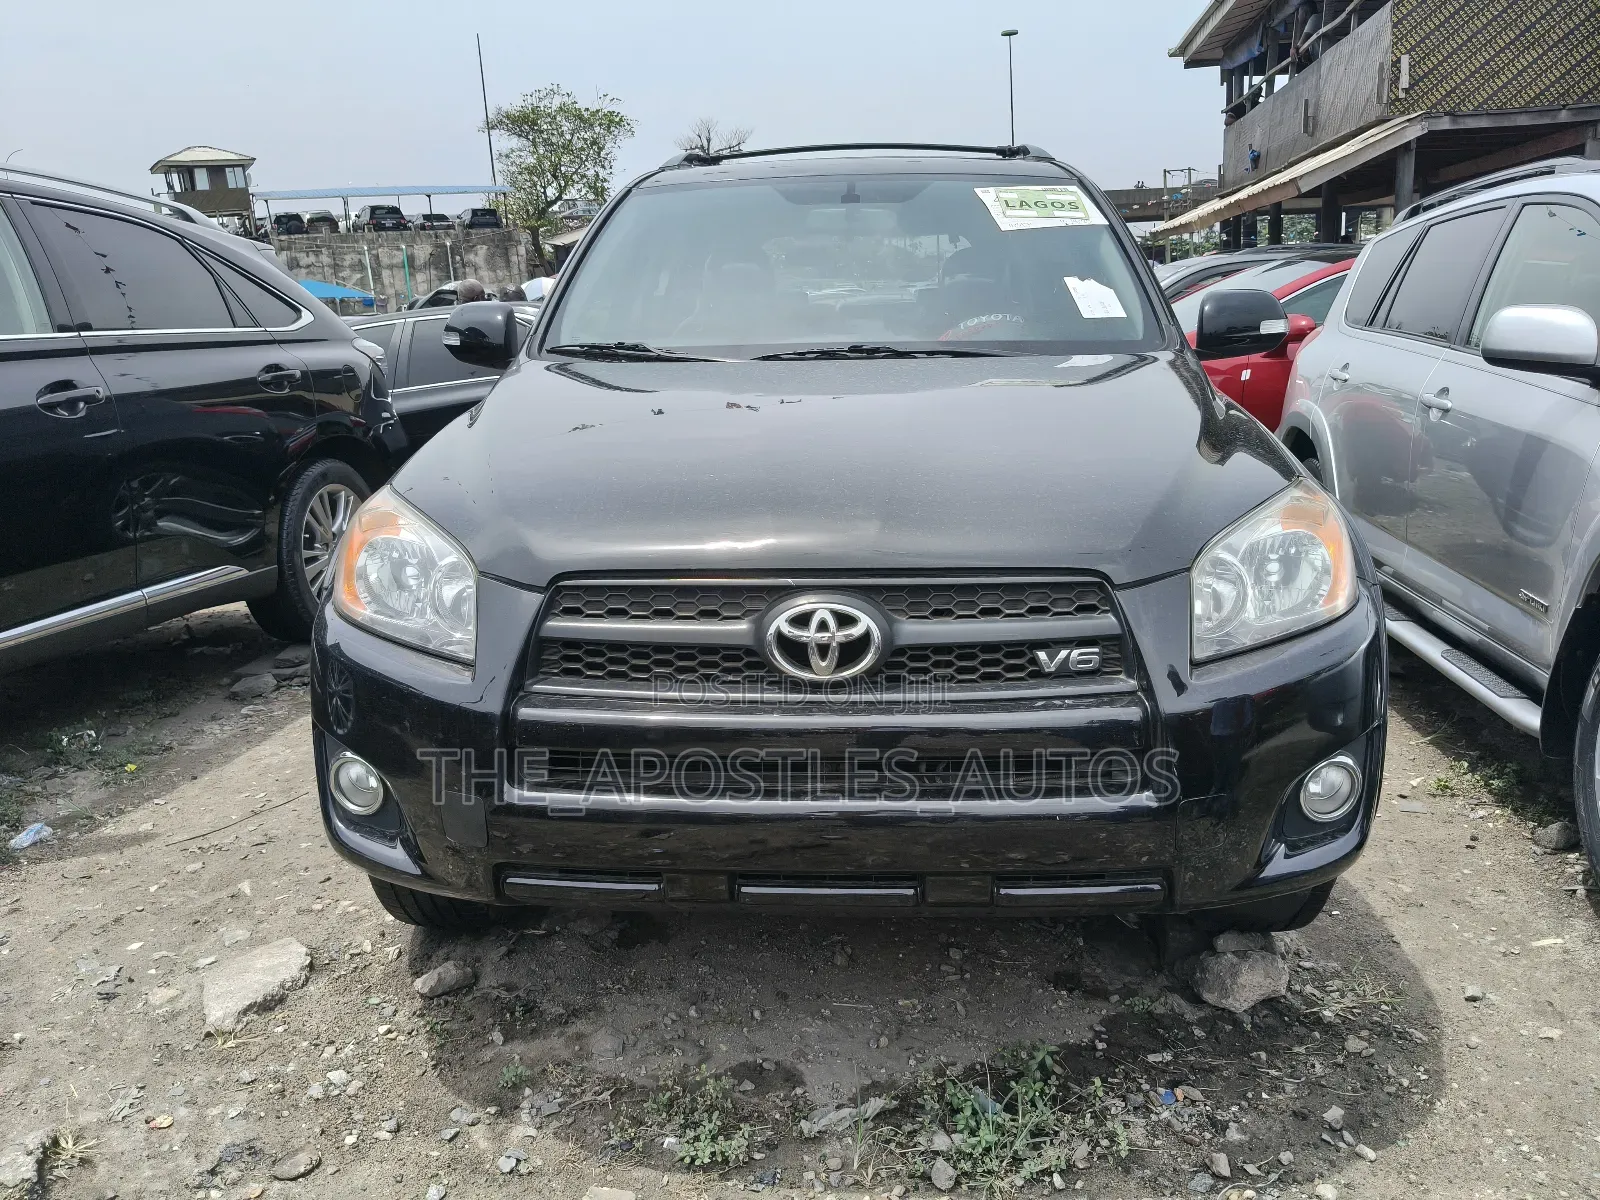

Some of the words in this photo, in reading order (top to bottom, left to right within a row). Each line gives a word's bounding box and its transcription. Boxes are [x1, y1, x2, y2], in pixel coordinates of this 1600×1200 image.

[1003, 199, 1080, 210] LAGOS
[958, 313, 1025, 329] TOYOTA
[1035, 648, 1100, 673] V6
